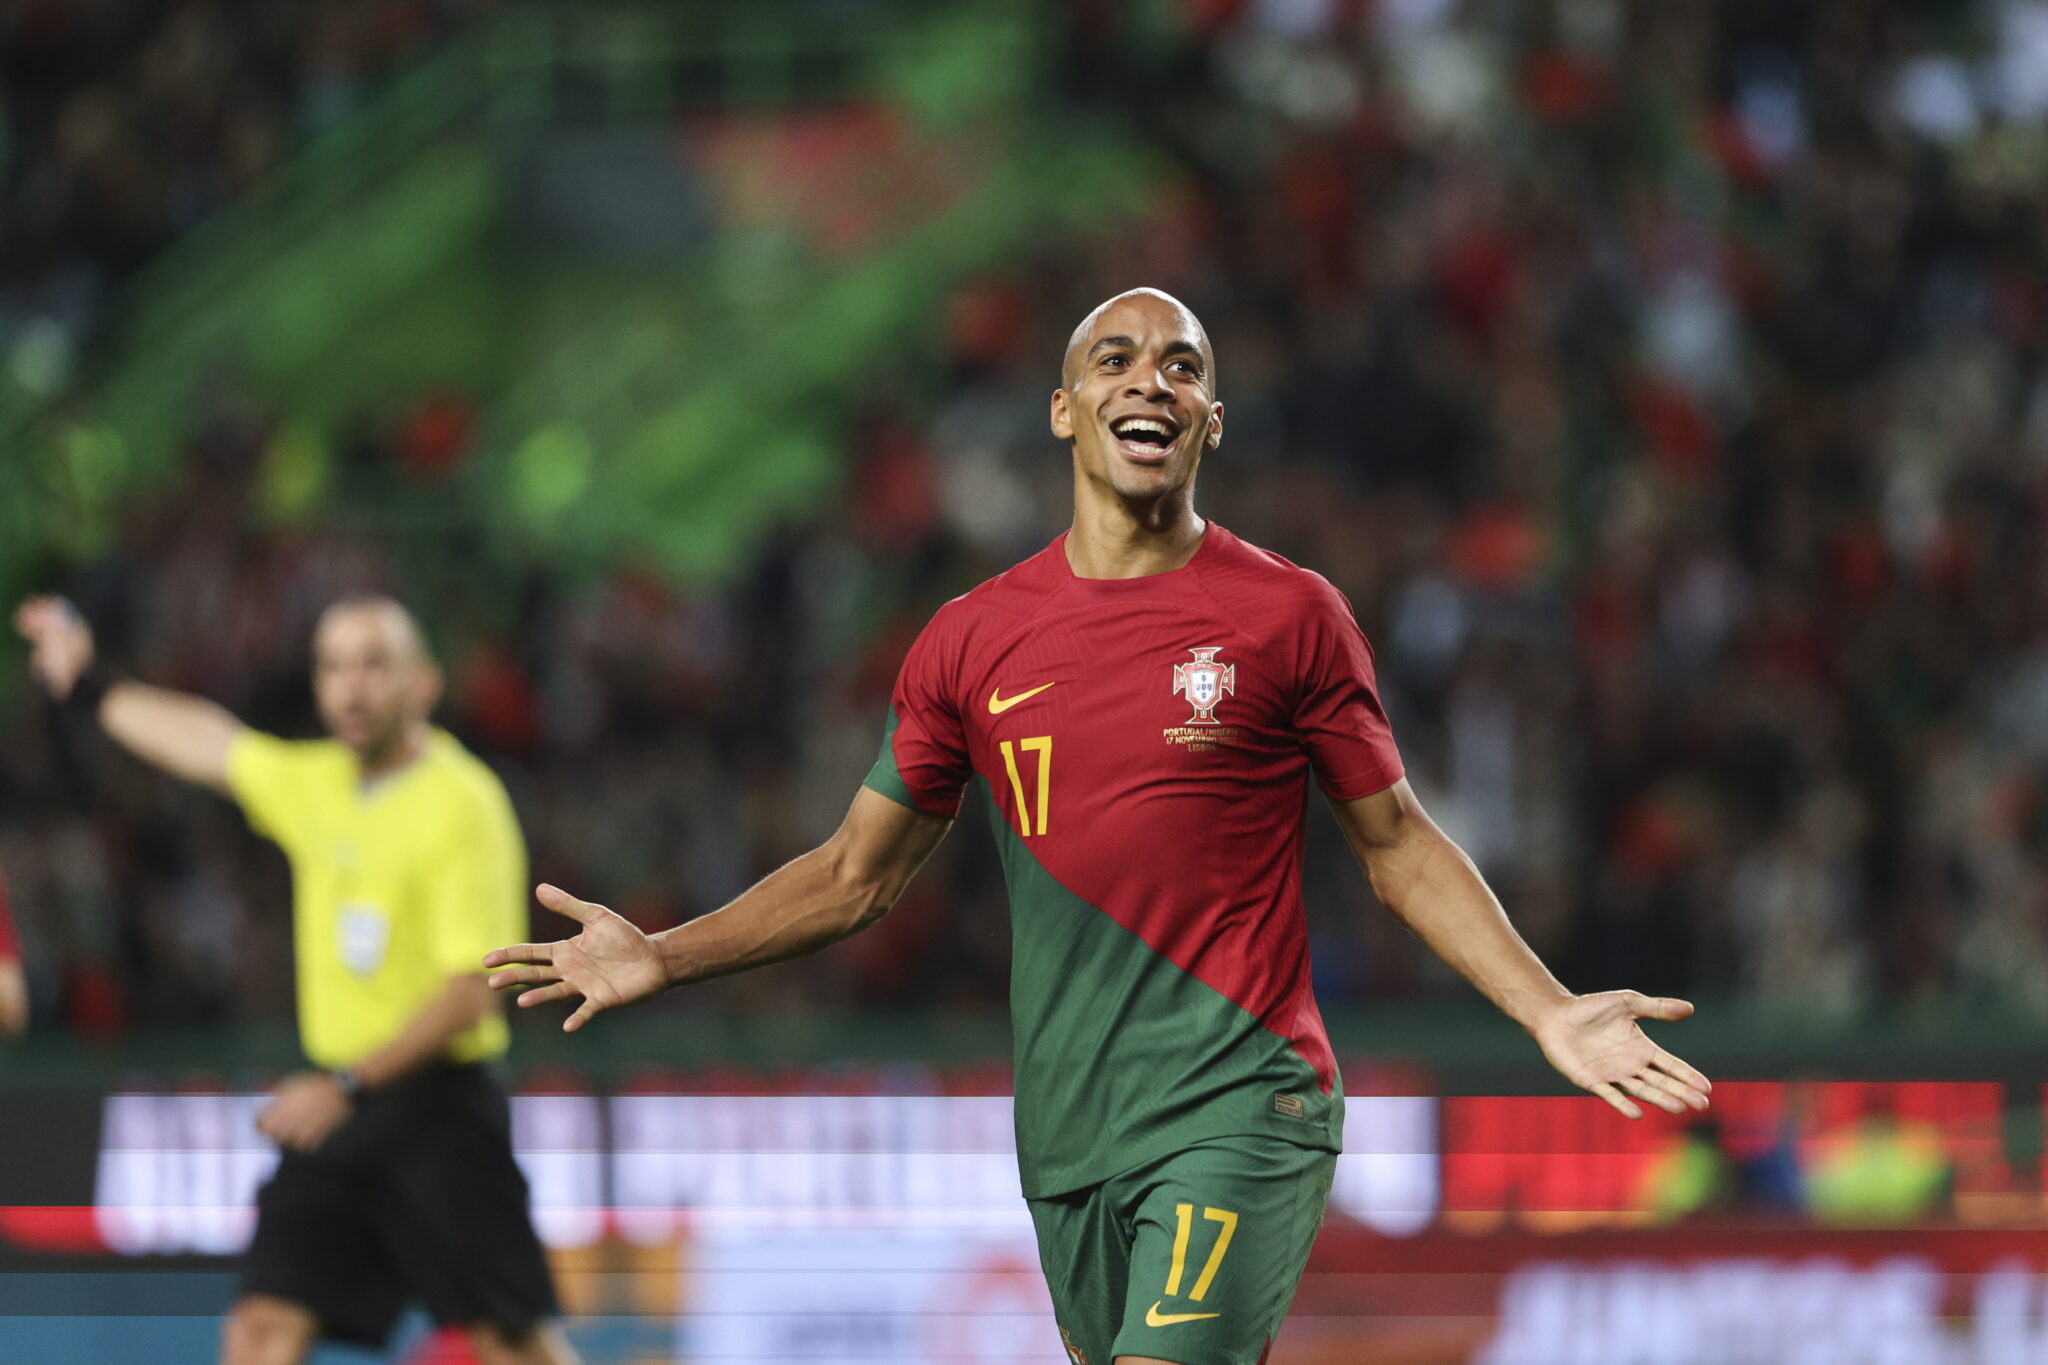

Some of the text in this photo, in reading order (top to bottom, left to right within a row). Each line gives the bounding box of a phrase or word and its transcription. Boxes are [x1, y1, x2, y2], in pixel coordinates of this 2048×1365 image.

[1166, 736, 1174, 745] 17
[1188, 744, 1216, 752] LISBOA
[1000, 736, 1052, 836] 17
[1164, 1203, 1238, 1302] 17
